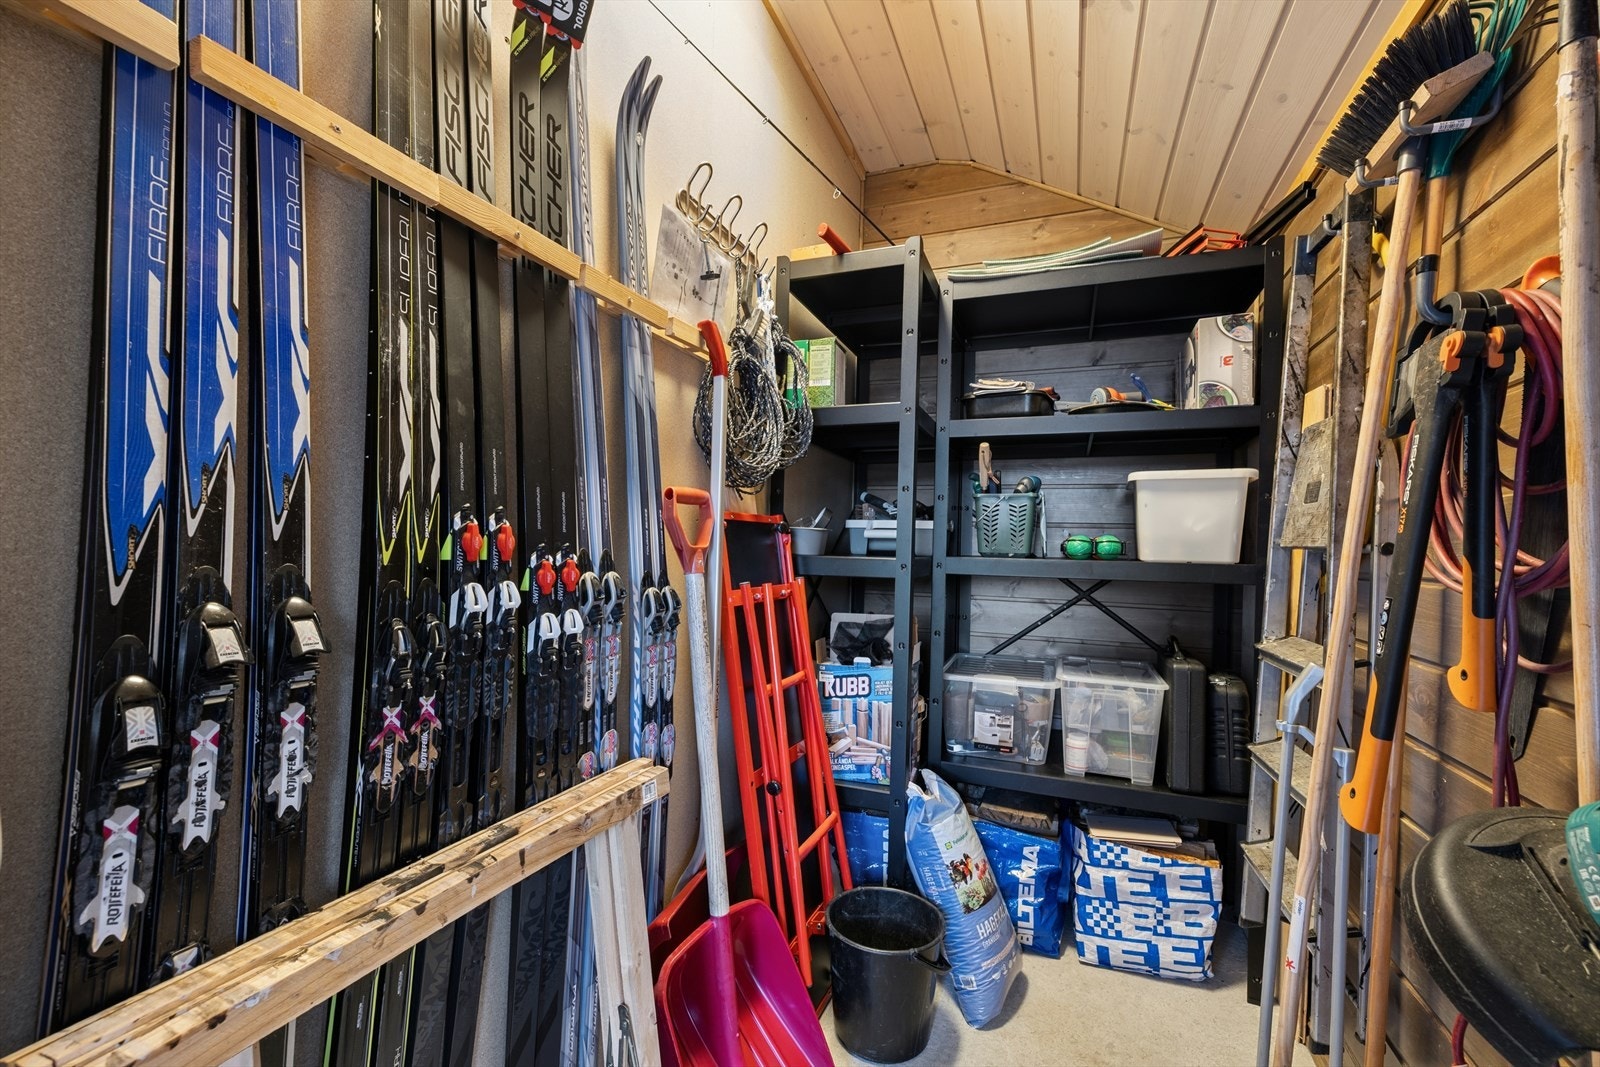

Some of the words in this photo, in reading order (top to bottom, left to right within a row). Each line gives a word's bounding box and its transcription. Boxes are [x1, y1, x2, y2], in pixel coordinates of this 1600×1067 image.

[573, 0, 589, 29] IGNOL
[441, 0, 463, 186] FISCHE
[1404, 434, 1419, 503] FISKARS
[633, 585, 641, 758] MADSHU
[824, 676, 870, 697] KUBB
[1018, 845, 1040, 946] BILTEMA
